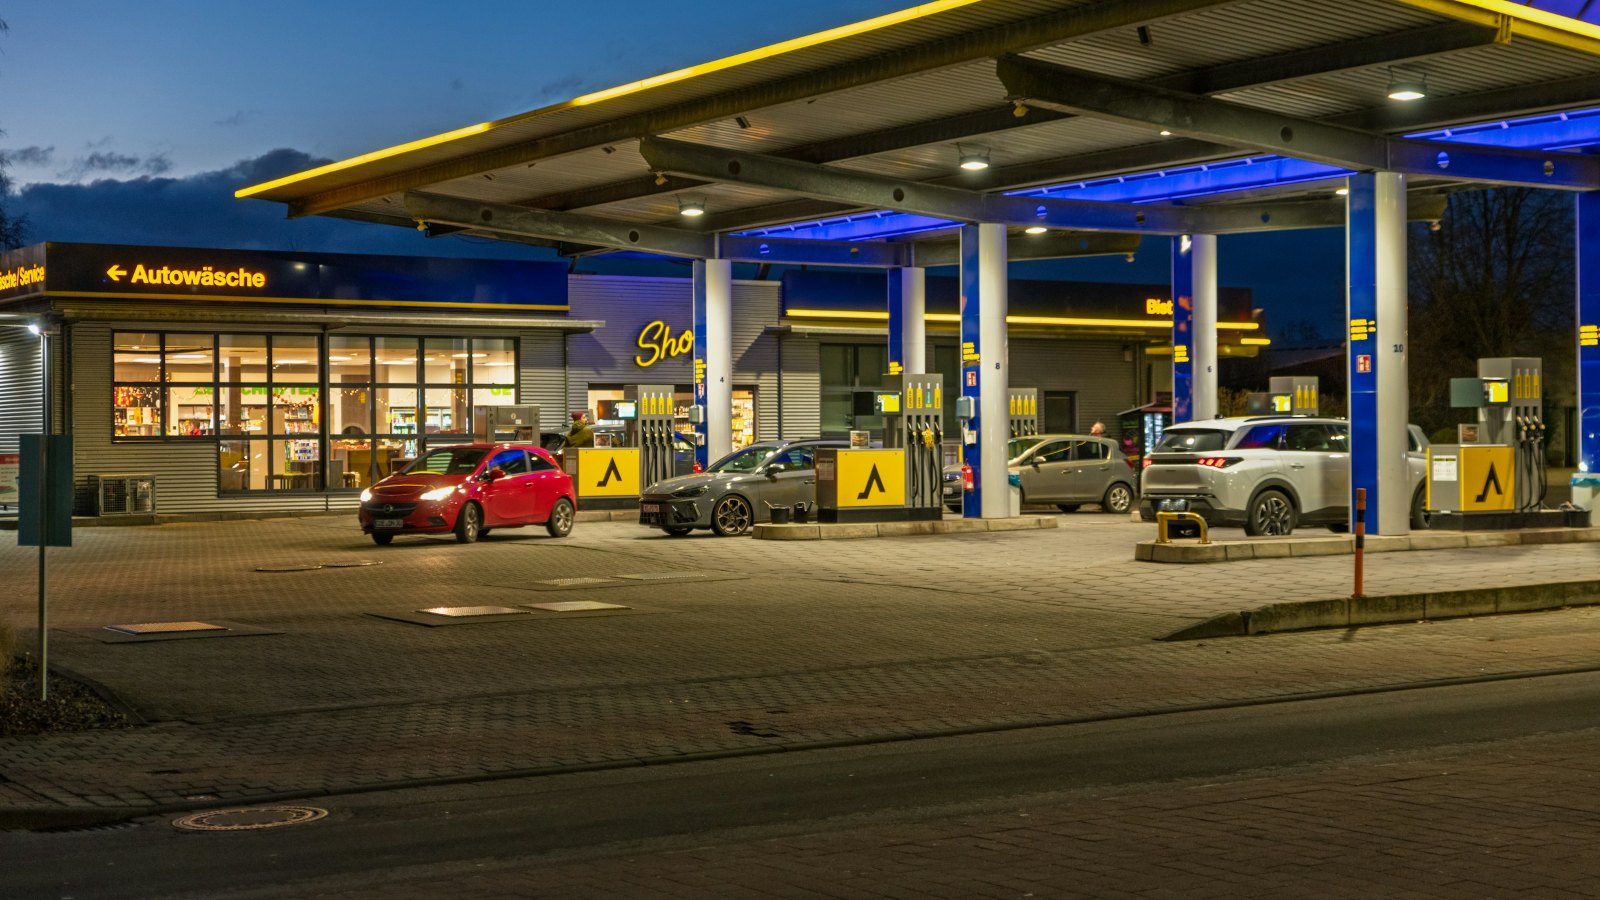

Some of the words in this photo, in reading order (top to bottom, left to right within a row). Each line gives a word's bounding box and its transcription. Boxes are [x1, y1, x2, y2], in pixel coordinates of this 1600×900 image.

[130, 264, 266, 288] Autowäsche
[636, 320, 694, 367] Sho
[1392, 343, 1404, 353] 10
[995, 362, 1001, 370] 8
